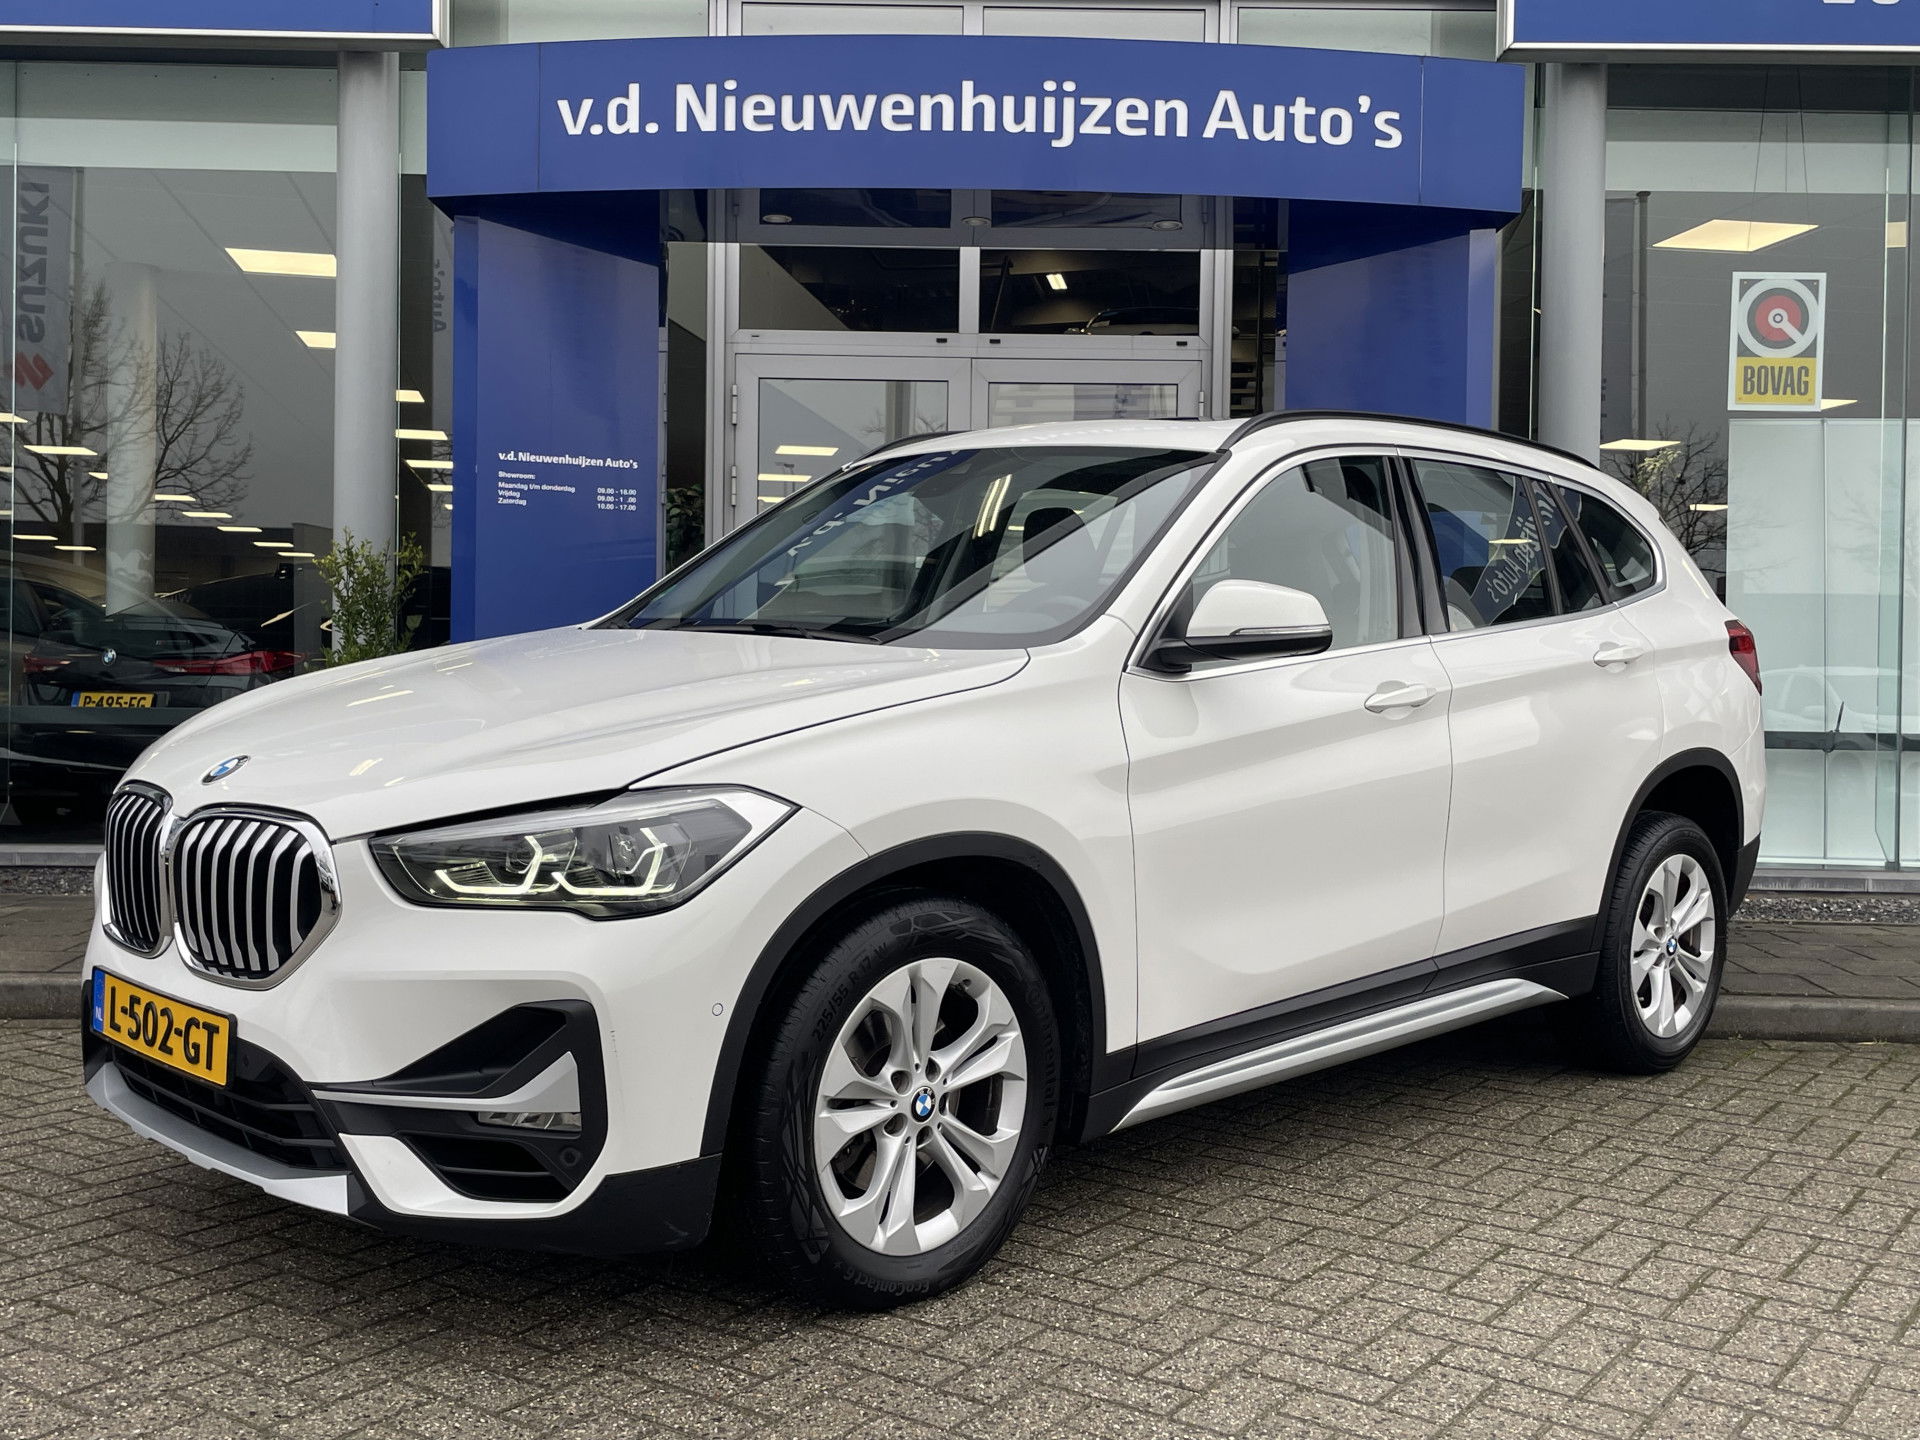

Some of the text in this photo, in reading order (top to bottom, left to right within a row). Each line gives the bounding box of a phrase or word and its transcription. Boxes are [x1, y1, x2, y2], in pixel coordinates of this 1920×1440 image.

[556, 79, 1403, 149] v.d. Nieuwenhuijzen Auto's
[1743, 365, 1809, 396] BOVAG
[498, 450, 638, 469] v.d. Nieuwenhuijzen Auto's
[498, 470, 536, 480] Showroom:
[498, 481, 529, 491] Maandag
[529, 483, 541, 491] t/m
[541, 484, 576, 494] donderdag
[498, 489, 521, 498] Vrijdag
[498, 497, 527, 507] Zaterdag
[95, 1005, 103, 1022] NL
[109, 985, 220, 1072] L-502-GT
